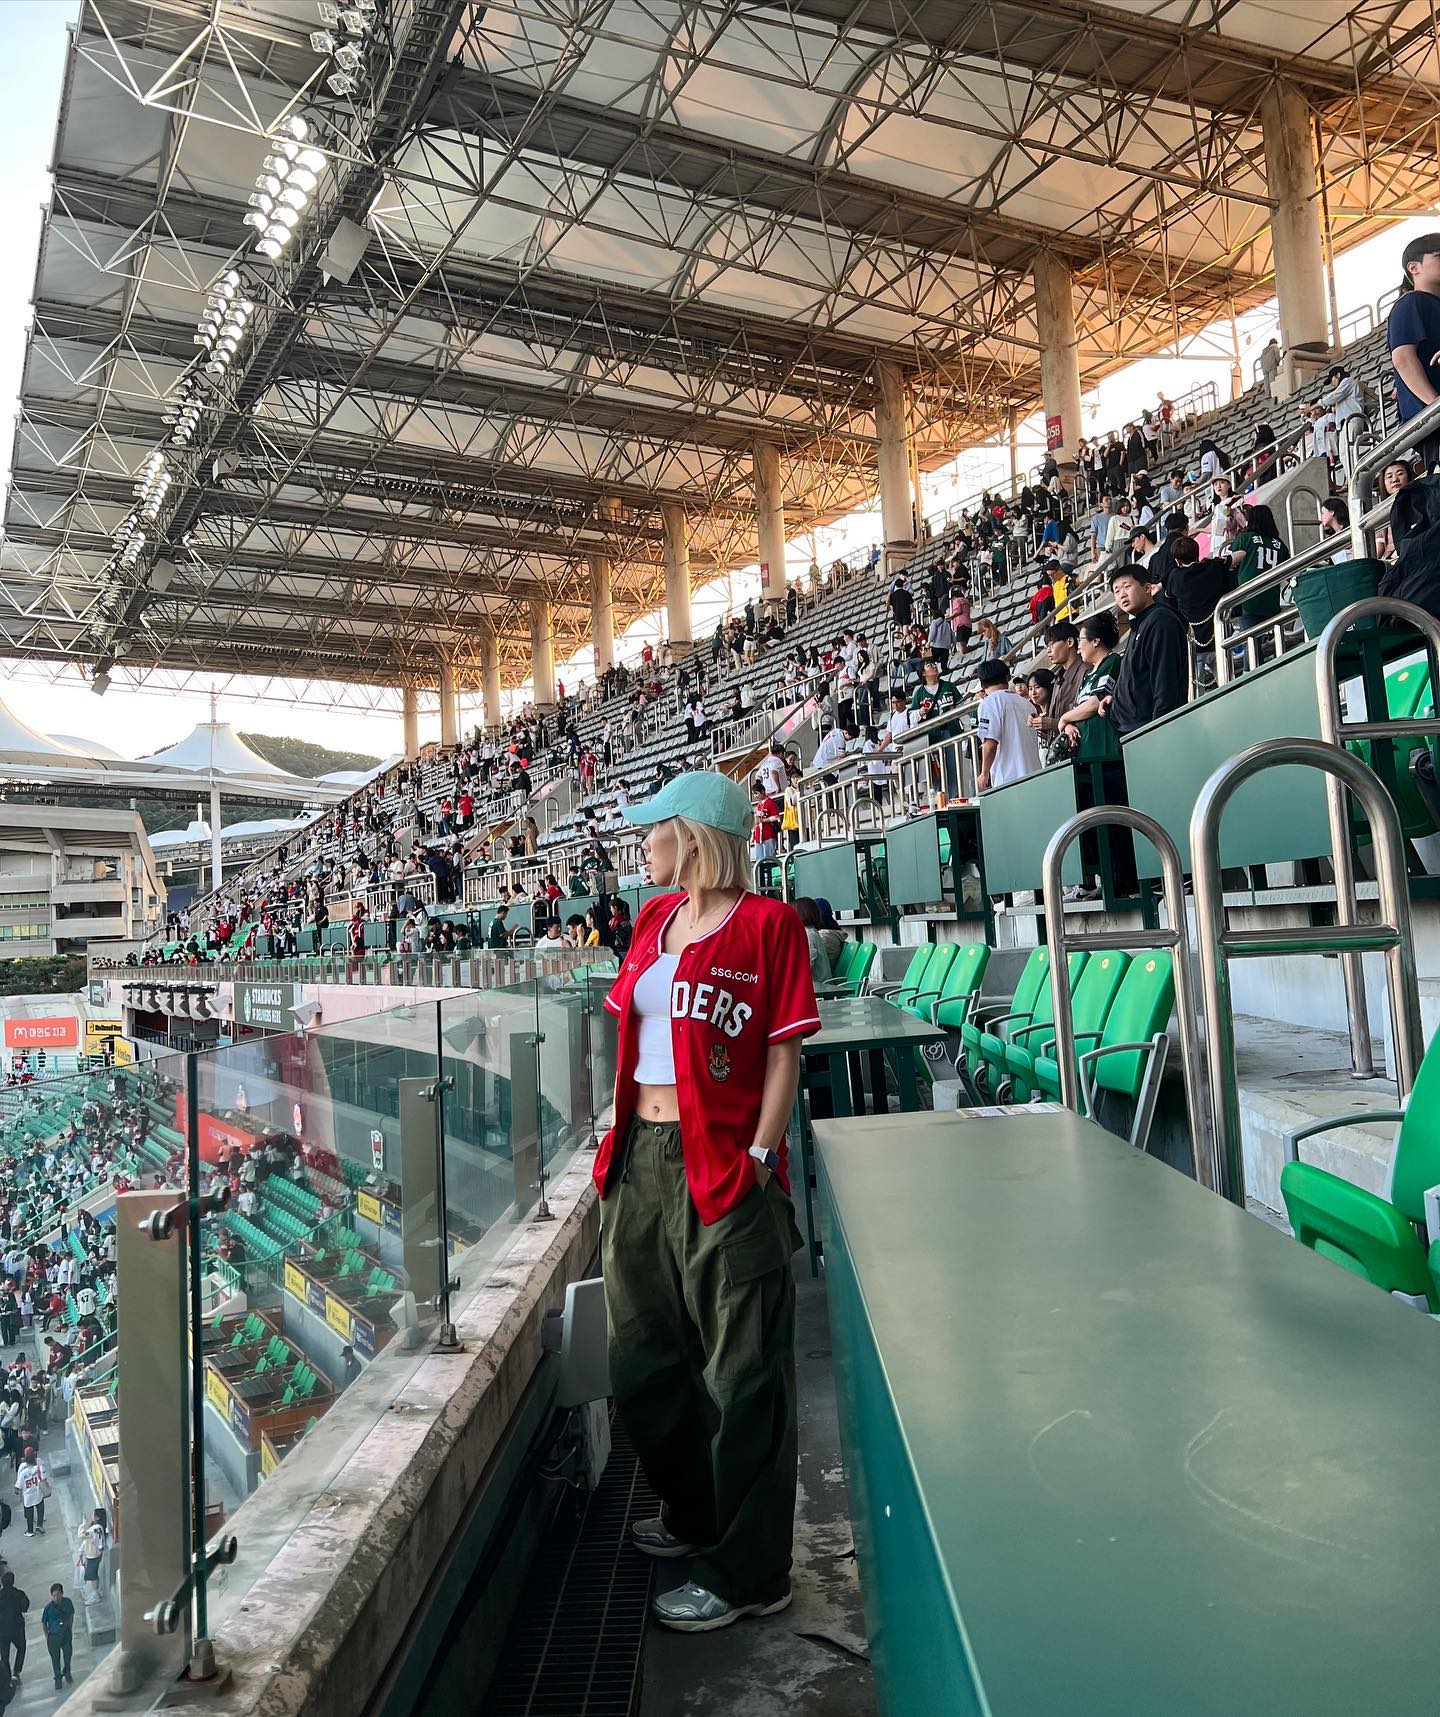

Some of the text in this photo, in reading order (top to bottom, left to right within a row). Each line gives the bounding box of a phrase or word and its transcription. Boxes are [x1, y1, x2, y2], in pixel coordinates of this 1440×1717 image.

[1257, 546, 1278, 569] 14
[710, 967, 758, 984] SSG.COM
[252, 988, 282, 1006] STARBUCKS
[671, 981, 752, 1037] DERS
[29, 1027, 51, 1038] 마인드
[52, 1026, 67, 1037] 치과
